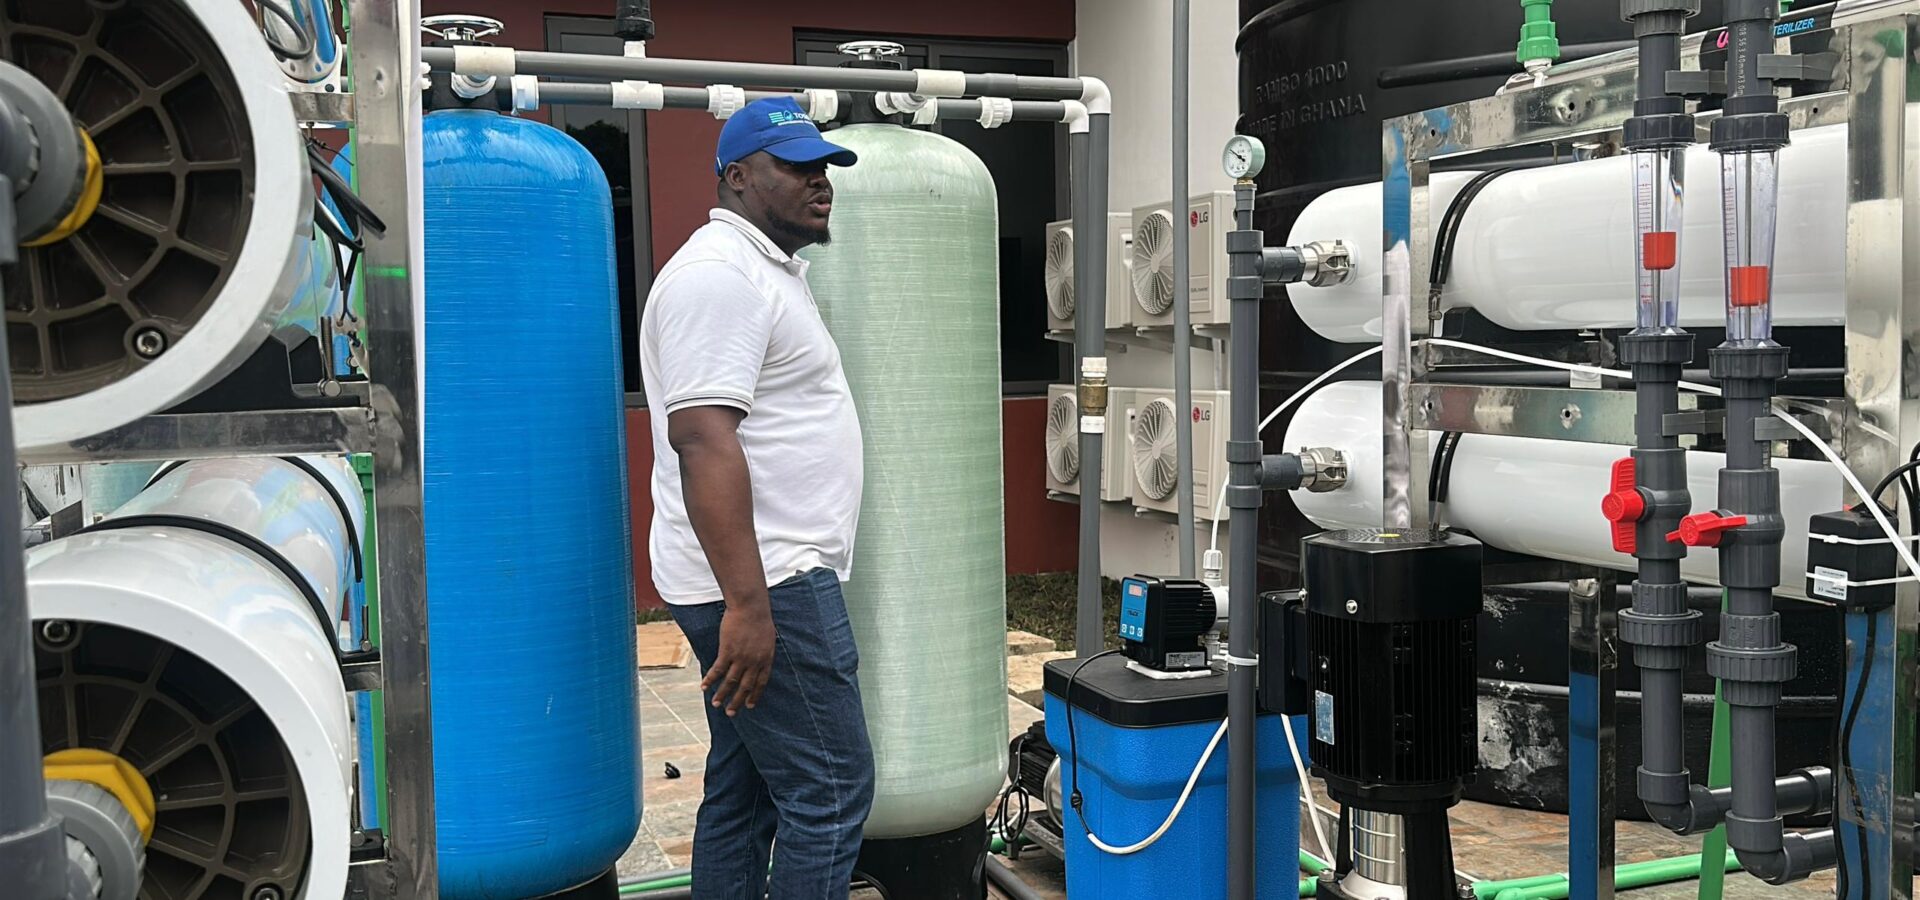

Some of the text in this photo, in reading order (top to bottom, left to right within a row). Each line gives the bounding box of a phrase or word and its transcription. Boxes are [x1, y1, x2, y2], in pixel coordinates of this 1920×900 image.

[1256, 60, 1348, 104] RAMBO 1000
[1280, 108, 1296, 129] IN
[1300, 93, 1367, 123] GHANA
[1199, 211, 1209, 223] LG
[1200, 410, 1211, 421] LG
